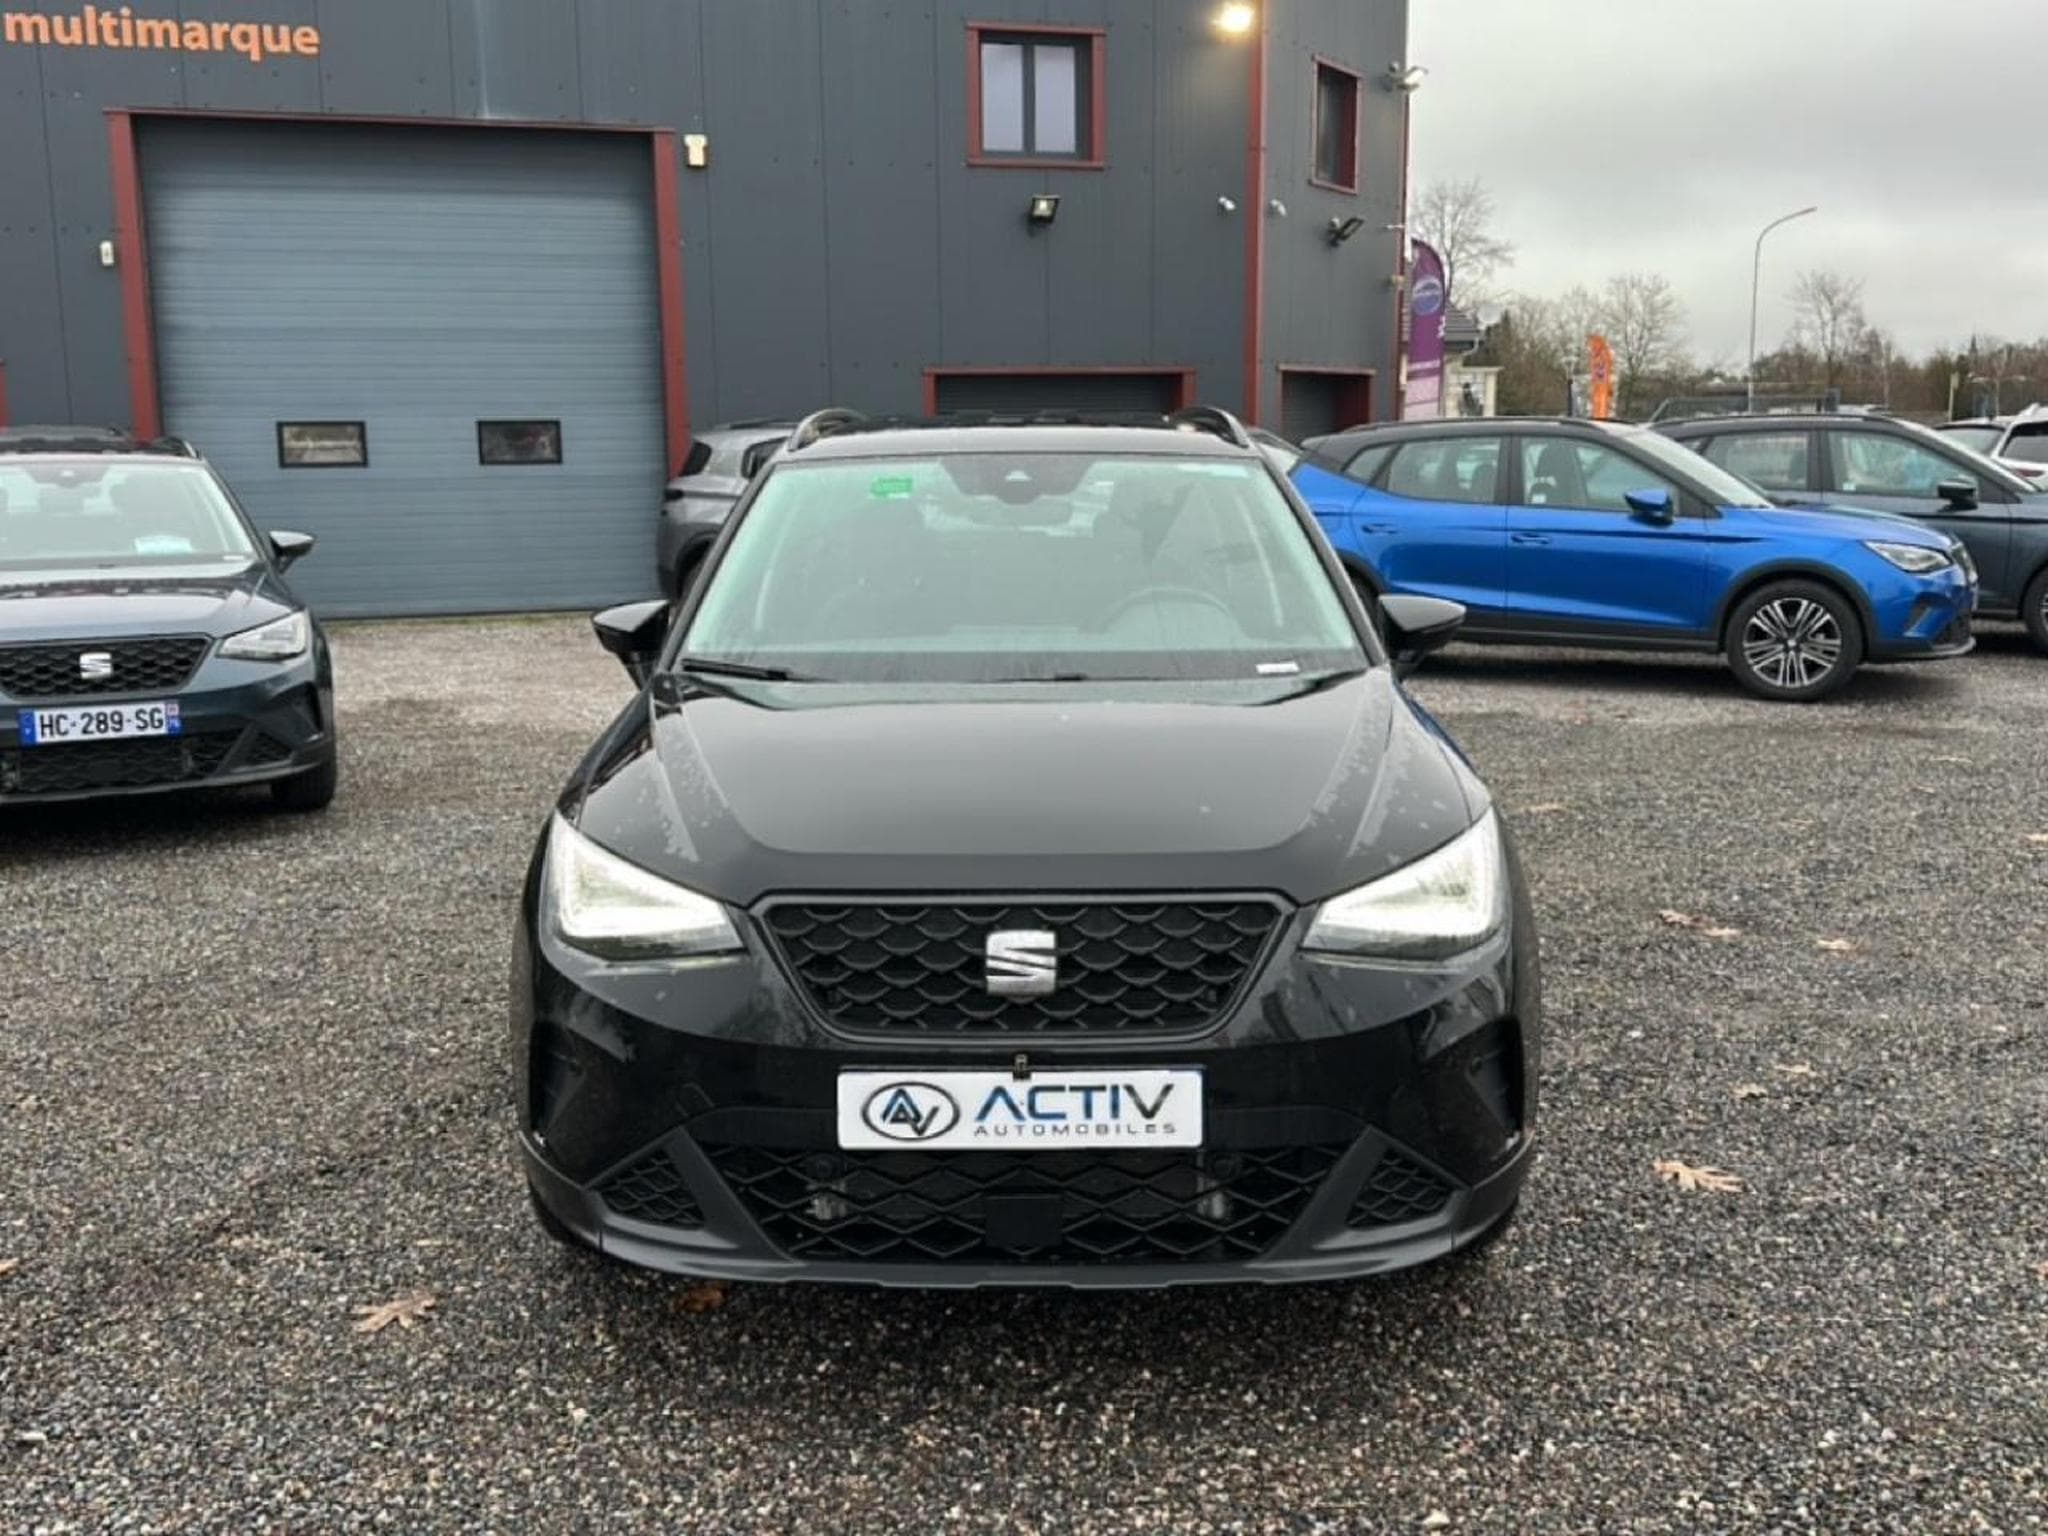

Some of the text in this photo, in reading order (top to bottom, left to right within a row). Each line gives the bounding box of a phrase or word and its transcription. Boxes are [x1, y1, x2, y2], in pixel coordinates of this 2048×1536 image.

[4, 5, 320, 61] multimarque
[975, 1083, 1175, 1121] ACTIV
[974, 1123, 1176, 1137] AUTOMOBILES
